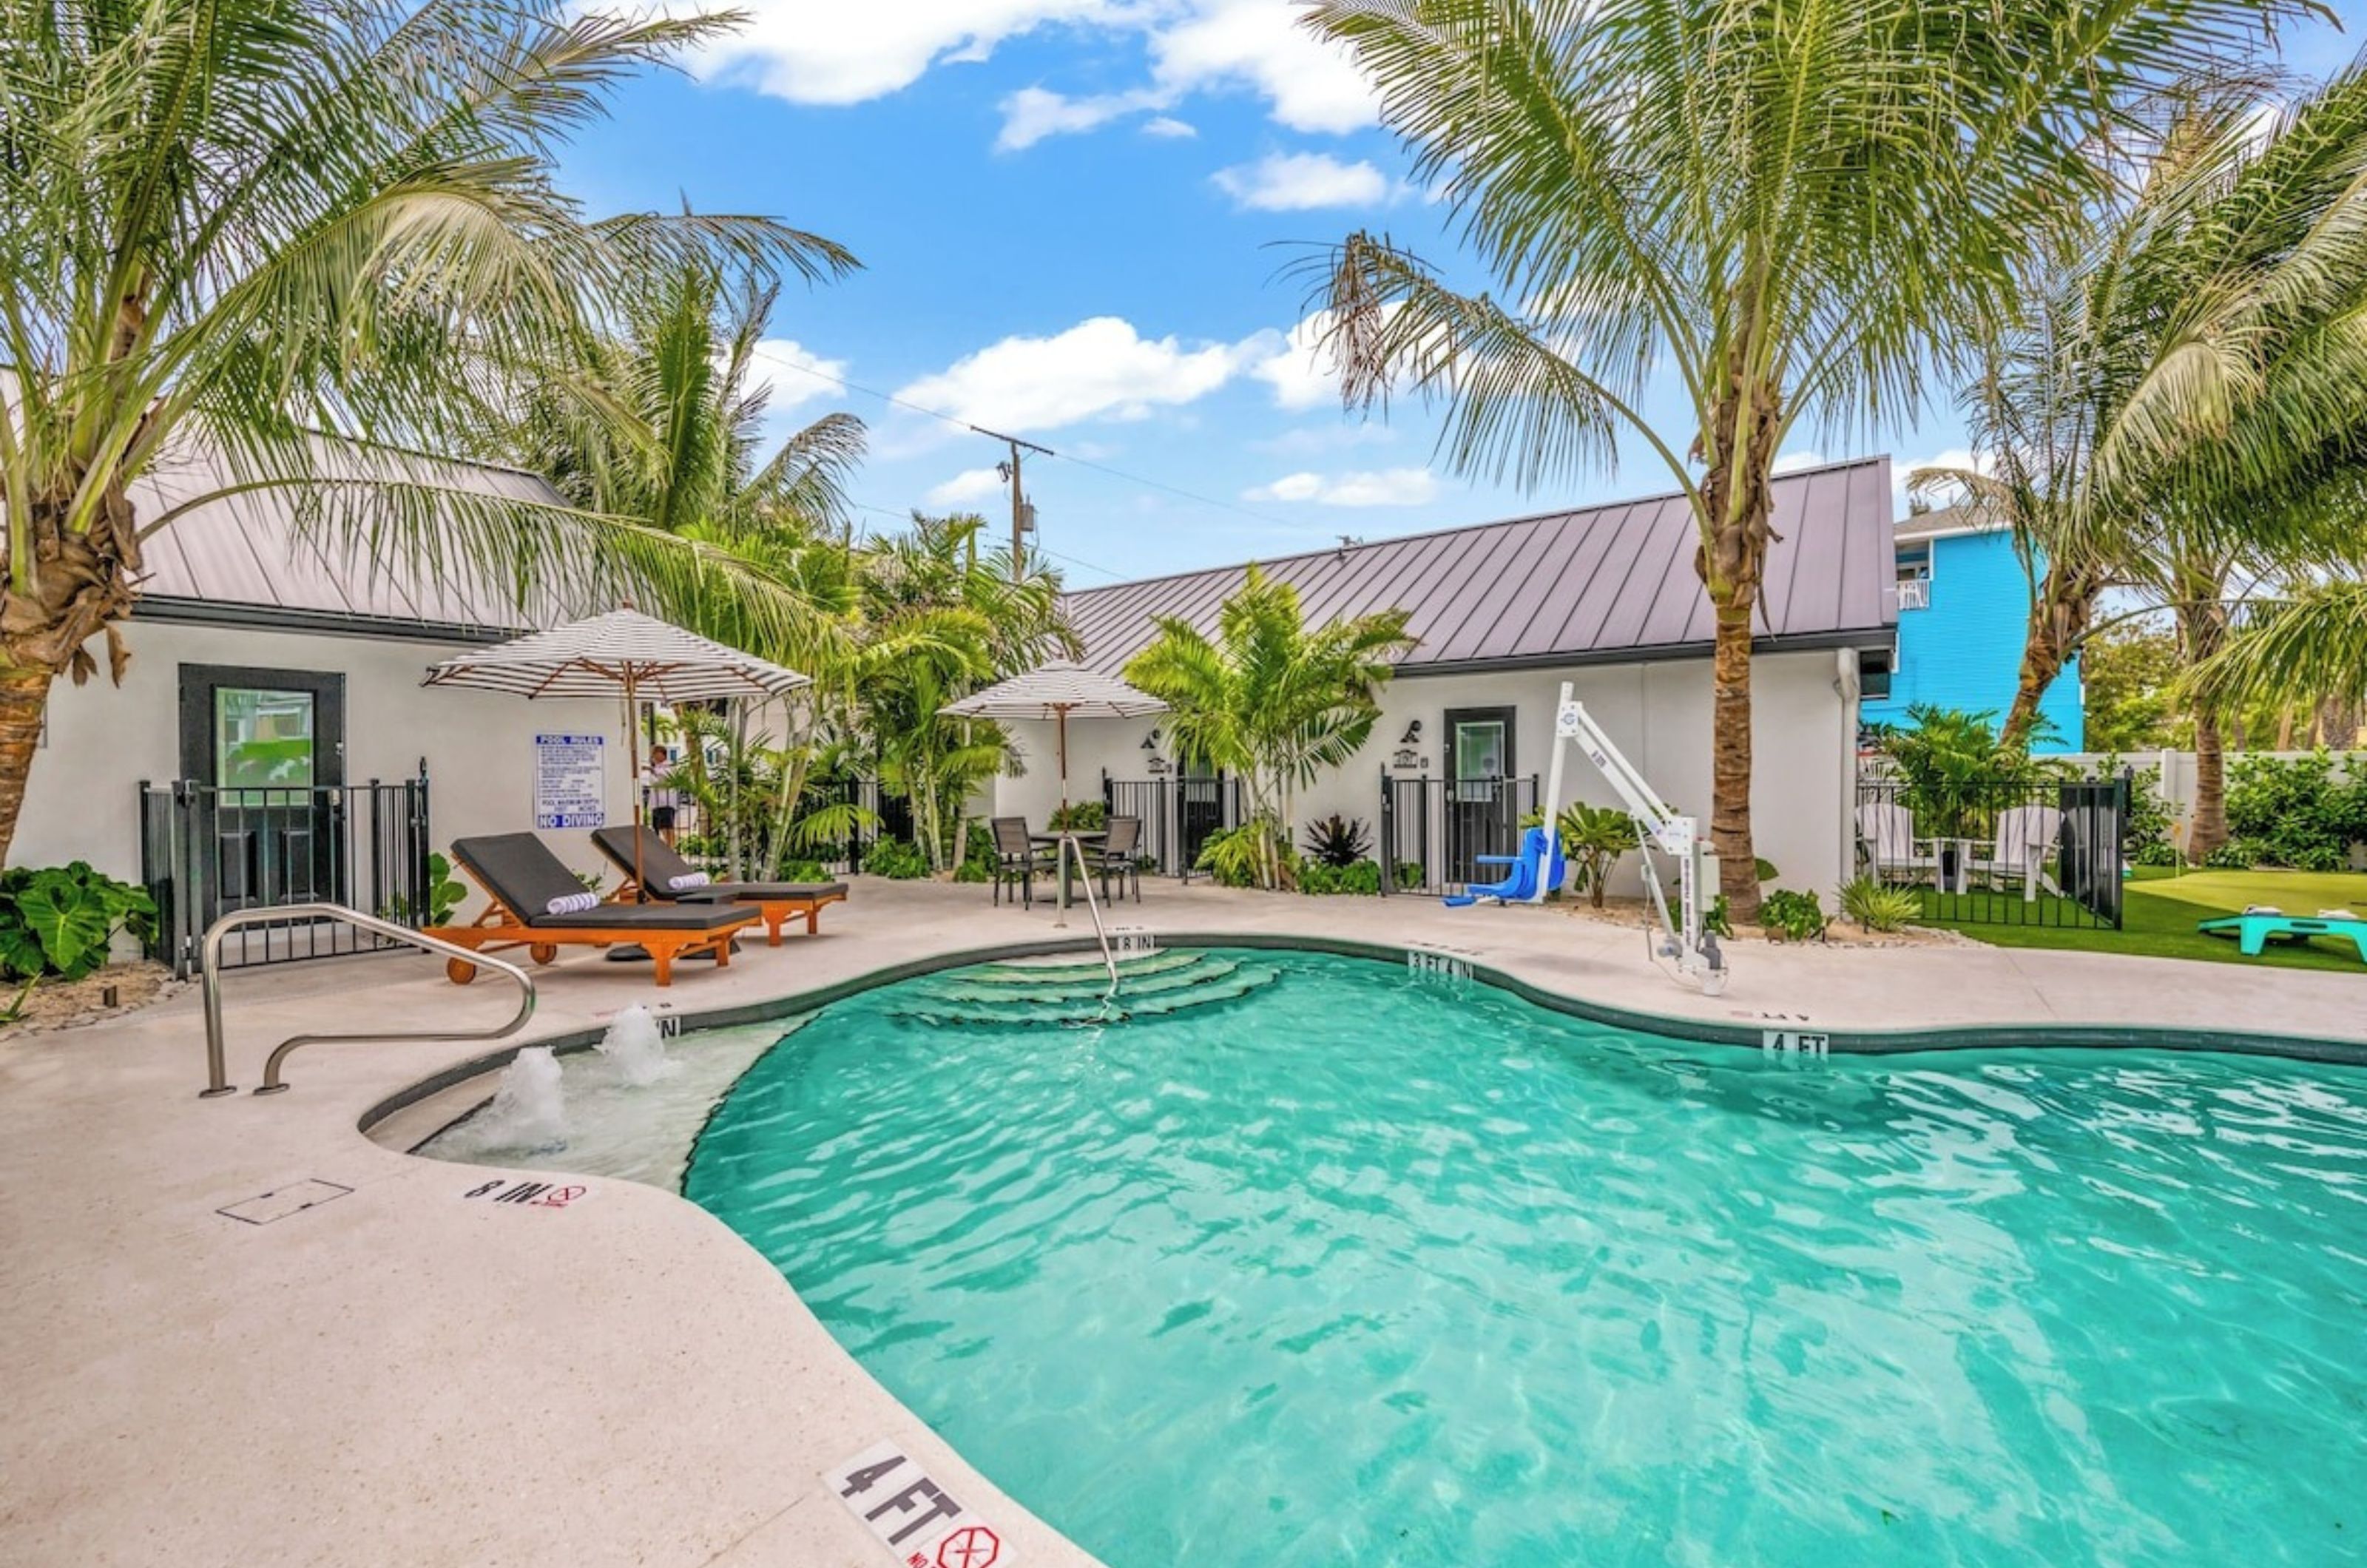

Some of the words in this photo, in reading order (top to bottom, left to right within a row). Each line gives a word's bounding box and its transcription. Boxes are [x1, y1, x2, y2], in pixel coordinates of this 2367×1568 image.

[541, 736, 564, 745] POOL
[539, 815, 557, 828] NO
[562, 813, 602, 827] DIVING
[1137, 934, 1151, 950] IN
[1425, 954, 1441, 973] FT
[1459, 959, 1470, 979] IN
[655, 1018, 676, 1039] N
[1773, 1033, 1785, 1051] 4
[1797, 1035, 1825, 1054] FT
[464, 1180, 505, 1198] 8
[493, 1182, 554, 1204] IN
[840, 1455, 907, 1498] 4
[865, 1477, 962, 1546] FT
